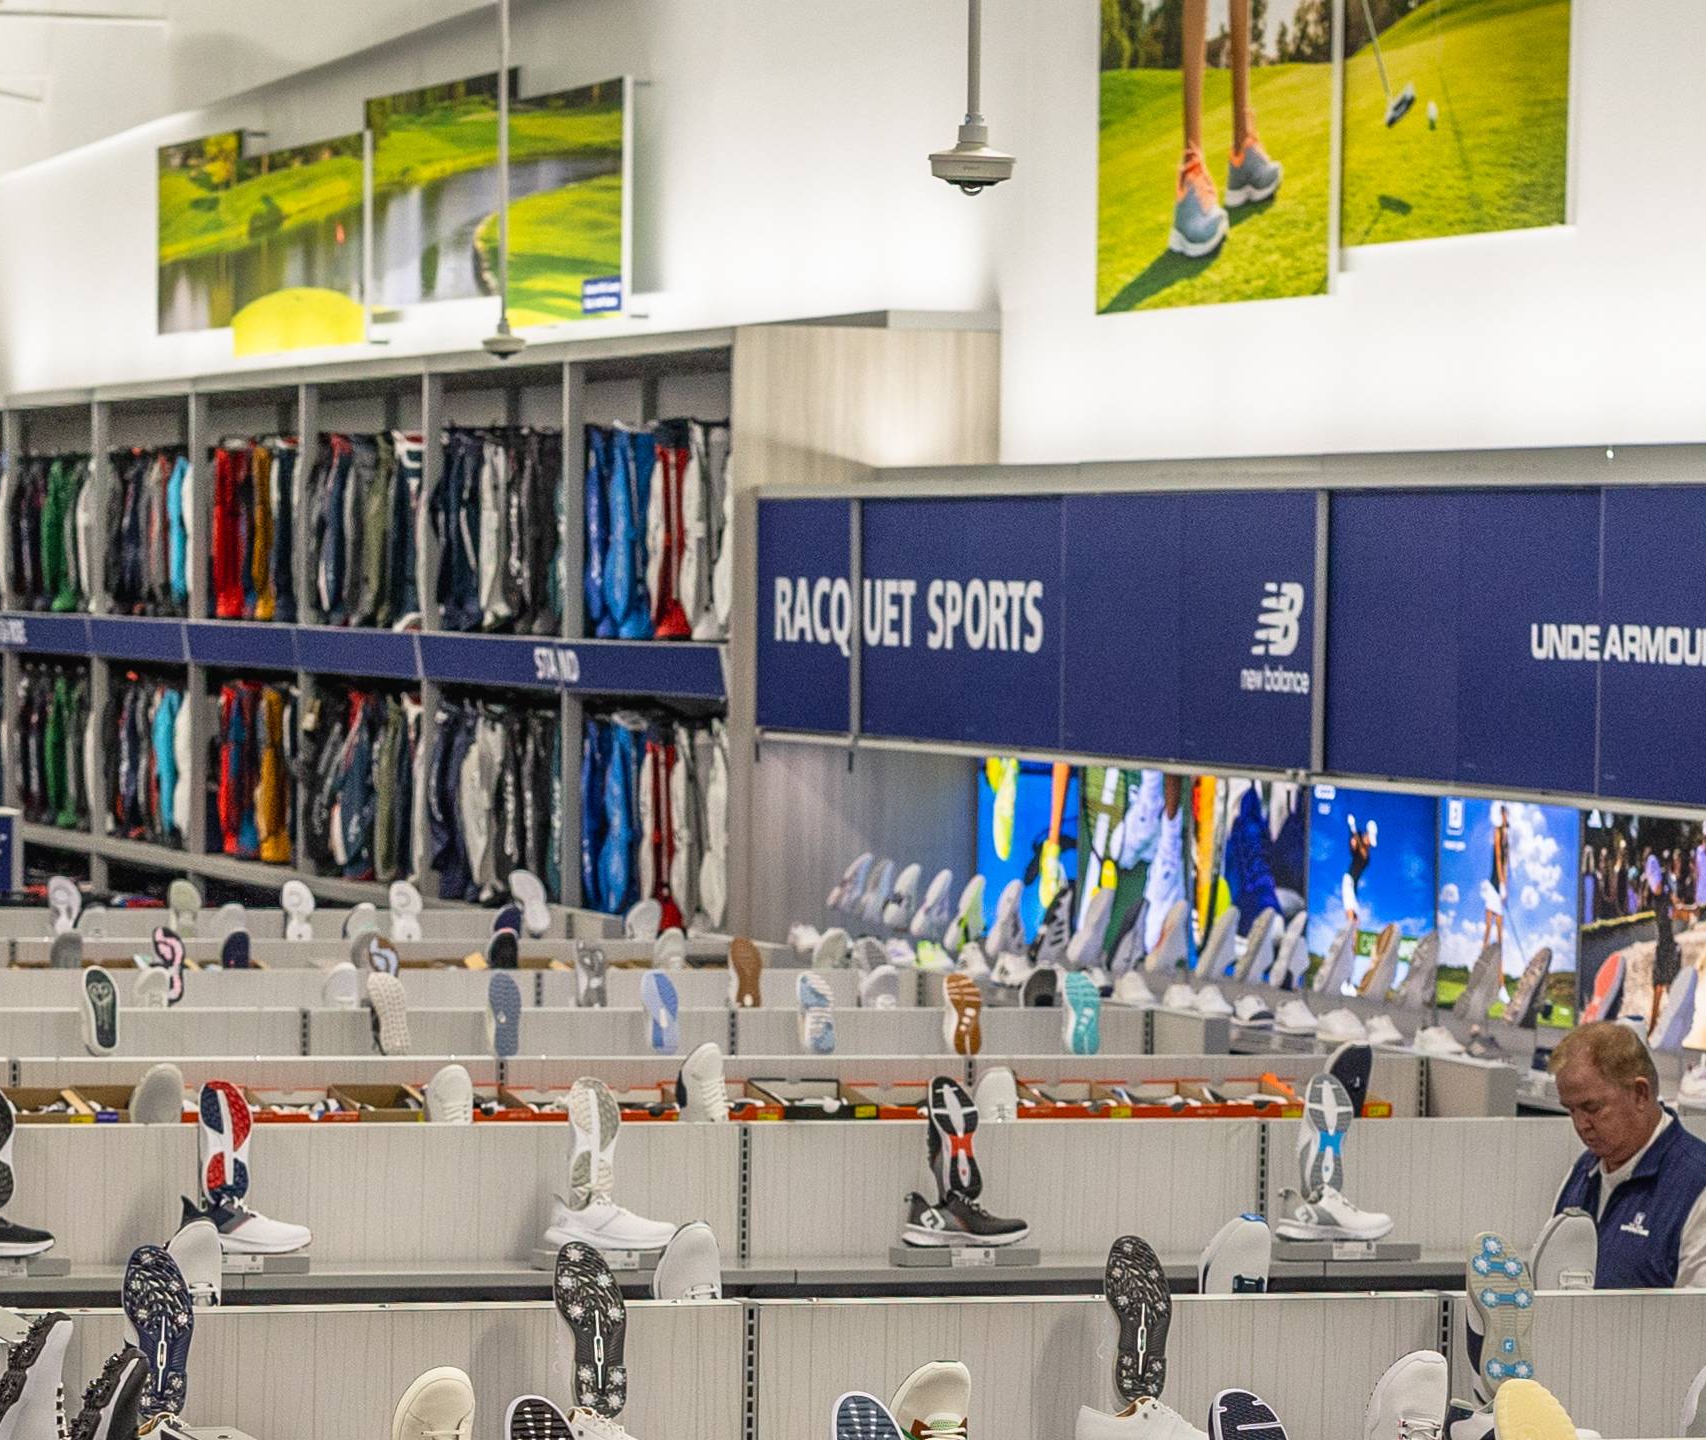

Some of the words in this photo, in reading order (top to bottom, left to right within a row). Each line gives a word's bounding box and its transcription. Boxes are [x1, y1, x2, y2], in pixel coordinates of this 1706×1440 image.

[775, 577, 917, 657] RACQUET
[927, 579, 1043, 654] SPORTS
[1240, 668, 1263, 691] new
[1264, 663, 1311, 693] balance
